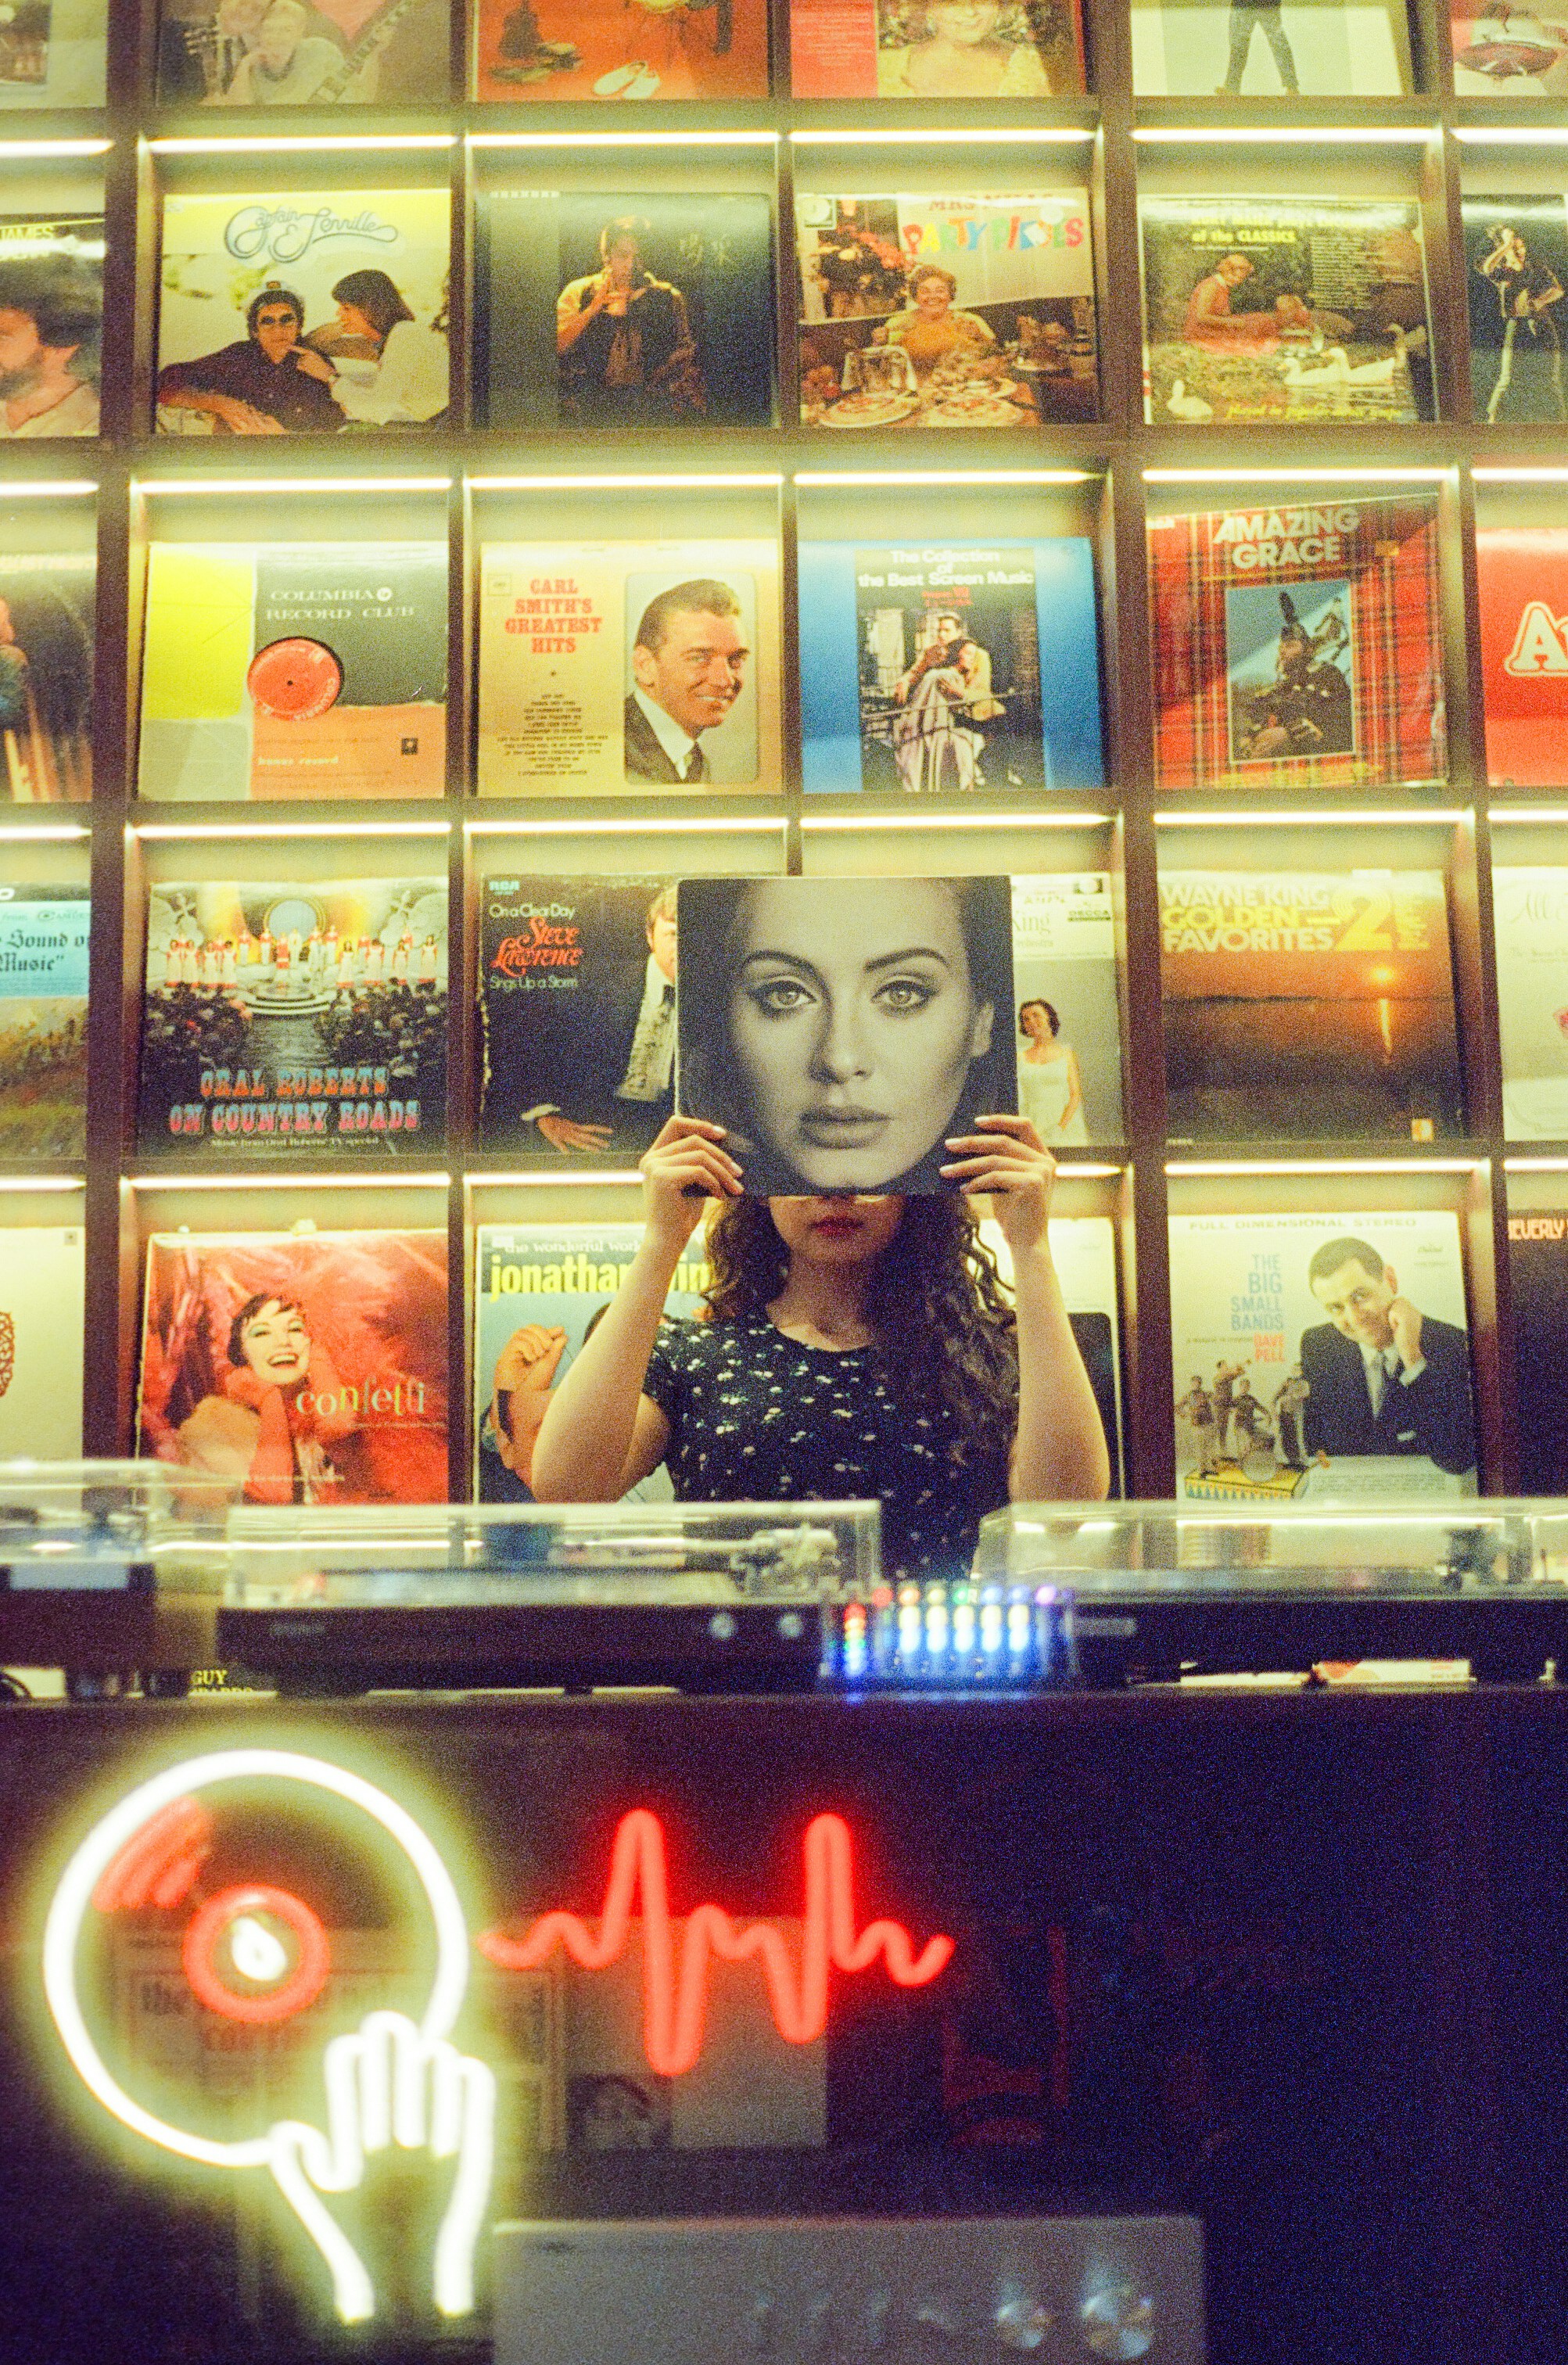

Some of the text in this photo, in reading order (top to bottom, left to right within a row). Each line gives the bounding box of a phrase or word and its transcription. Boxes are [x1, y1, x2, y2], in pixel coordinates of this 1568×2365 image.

[224, 206, 300, 259] Captain
[303, 206, 398, 244] Tennille
[902, 217, 988, 255] PARTY
[1192, 229, 1297, 242] of the CLASSICS
[1212, 508, 1360, 544] AMAZING
[890, 550, 1000, 563] The Collection
[1232, 536, 1341, 569] GRACE
[936, 562, 954, 573] of
[529, 578, 579, 595] CARL
[857, 570, 1035, 587] the Best Screen Music
[270, 589, 374, 601] COLUMBIA
[267, 605, 414, 621] RECORD CLUB
[514, 598, 593, 615] SMITH'S
[504, 616, 603, 634] GREATEST
[530, 637, 576, 655] HITS
[1504, 601, 1568, 678] A
[1160, 882, 1329, 907] WAYNE KING
[489, 903, 508, 918] On
[519, 903, 549, 917] Clear
[551, 903, 576, 921] Day
[1162, 905, 1300, 930] GOLDEN
[7, 929, 69, 949] Sound
[1162, 928, 1336, 953] FAVORITES
[518, 976, 536, 991] Up
[200, 1066, 388, 1097] ORAL ROBERTS
[169, 1100, 420, 1133] ON COUNTRY ROADS
[1189, 1218, 1416, 1230] FULL DIMENSIONAL STEREO
[1508, 1218, 1565, 1240] EVERLY
[533, 1240, 603, 1252] wonderful
[1251, 1254, 1279, 1270] THE
[489, 1253, 630, 1303] jonatha
[1248, 1272, 1283, 1294] BIG
[1231, 1296, 1283, 1312] SMALL
[1231, 1314, 1284, 1330] BANDS
[1254, 1333, 1285, 1348] DAVE
[1254, 1348, 1286, 1363] PELL
[296, 1376, 425, 1417] confetti
[191, 1669, 228, 1685] GUY
